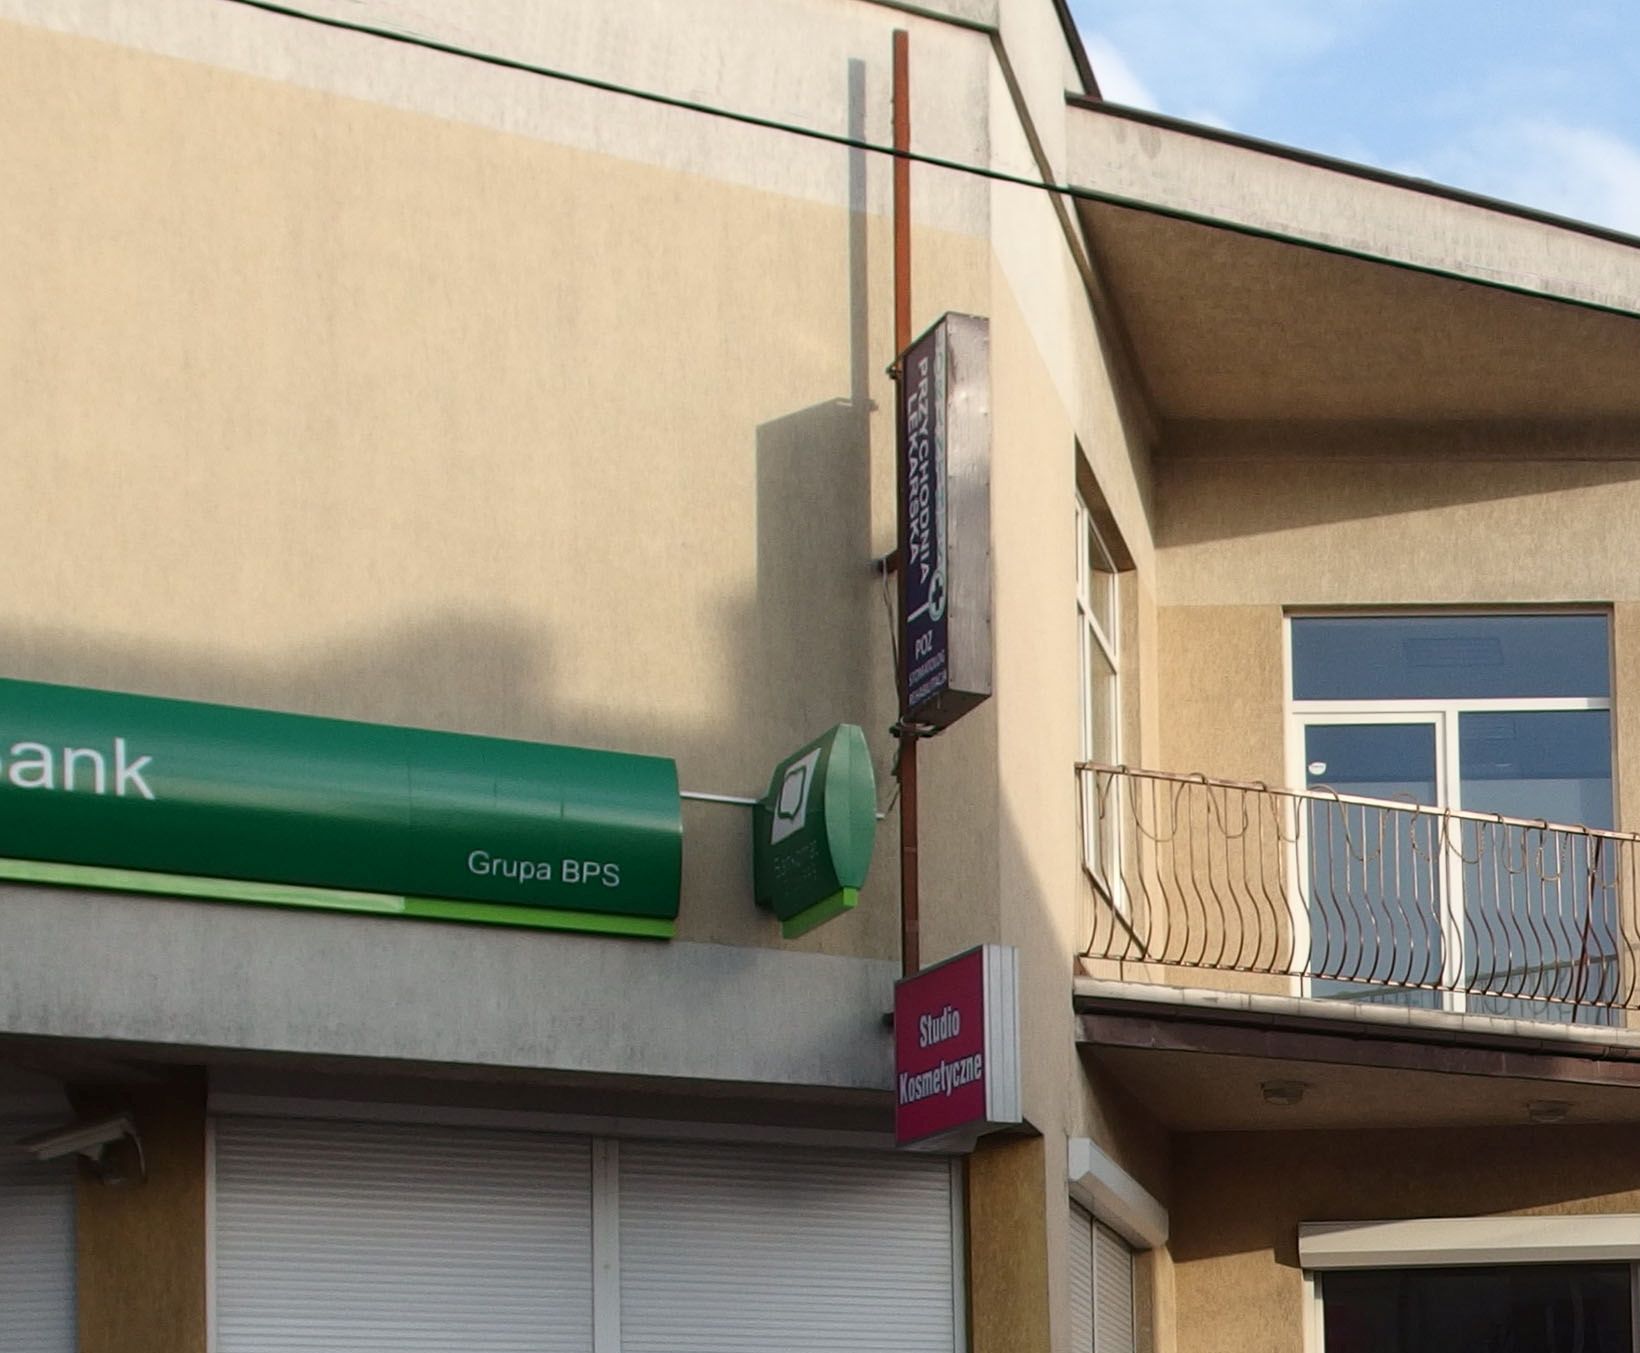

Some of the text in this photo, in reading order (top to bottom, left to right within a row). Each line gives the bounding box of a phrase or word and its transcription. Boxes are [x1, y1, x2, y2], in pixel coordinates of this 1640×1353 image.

[907, 393, 919, 565] LEKARSKA
[917, 356, 930, 585] PRZYCHODNIA
[915, 630, 933, 661] POZ
[0, 738, 155, 800] ank
[468, 850, 620, 887] Grupa BPS
[919, 1006, 961, 1047] Studio
[900, 1053, 982, 1104] Kosmetyczne
